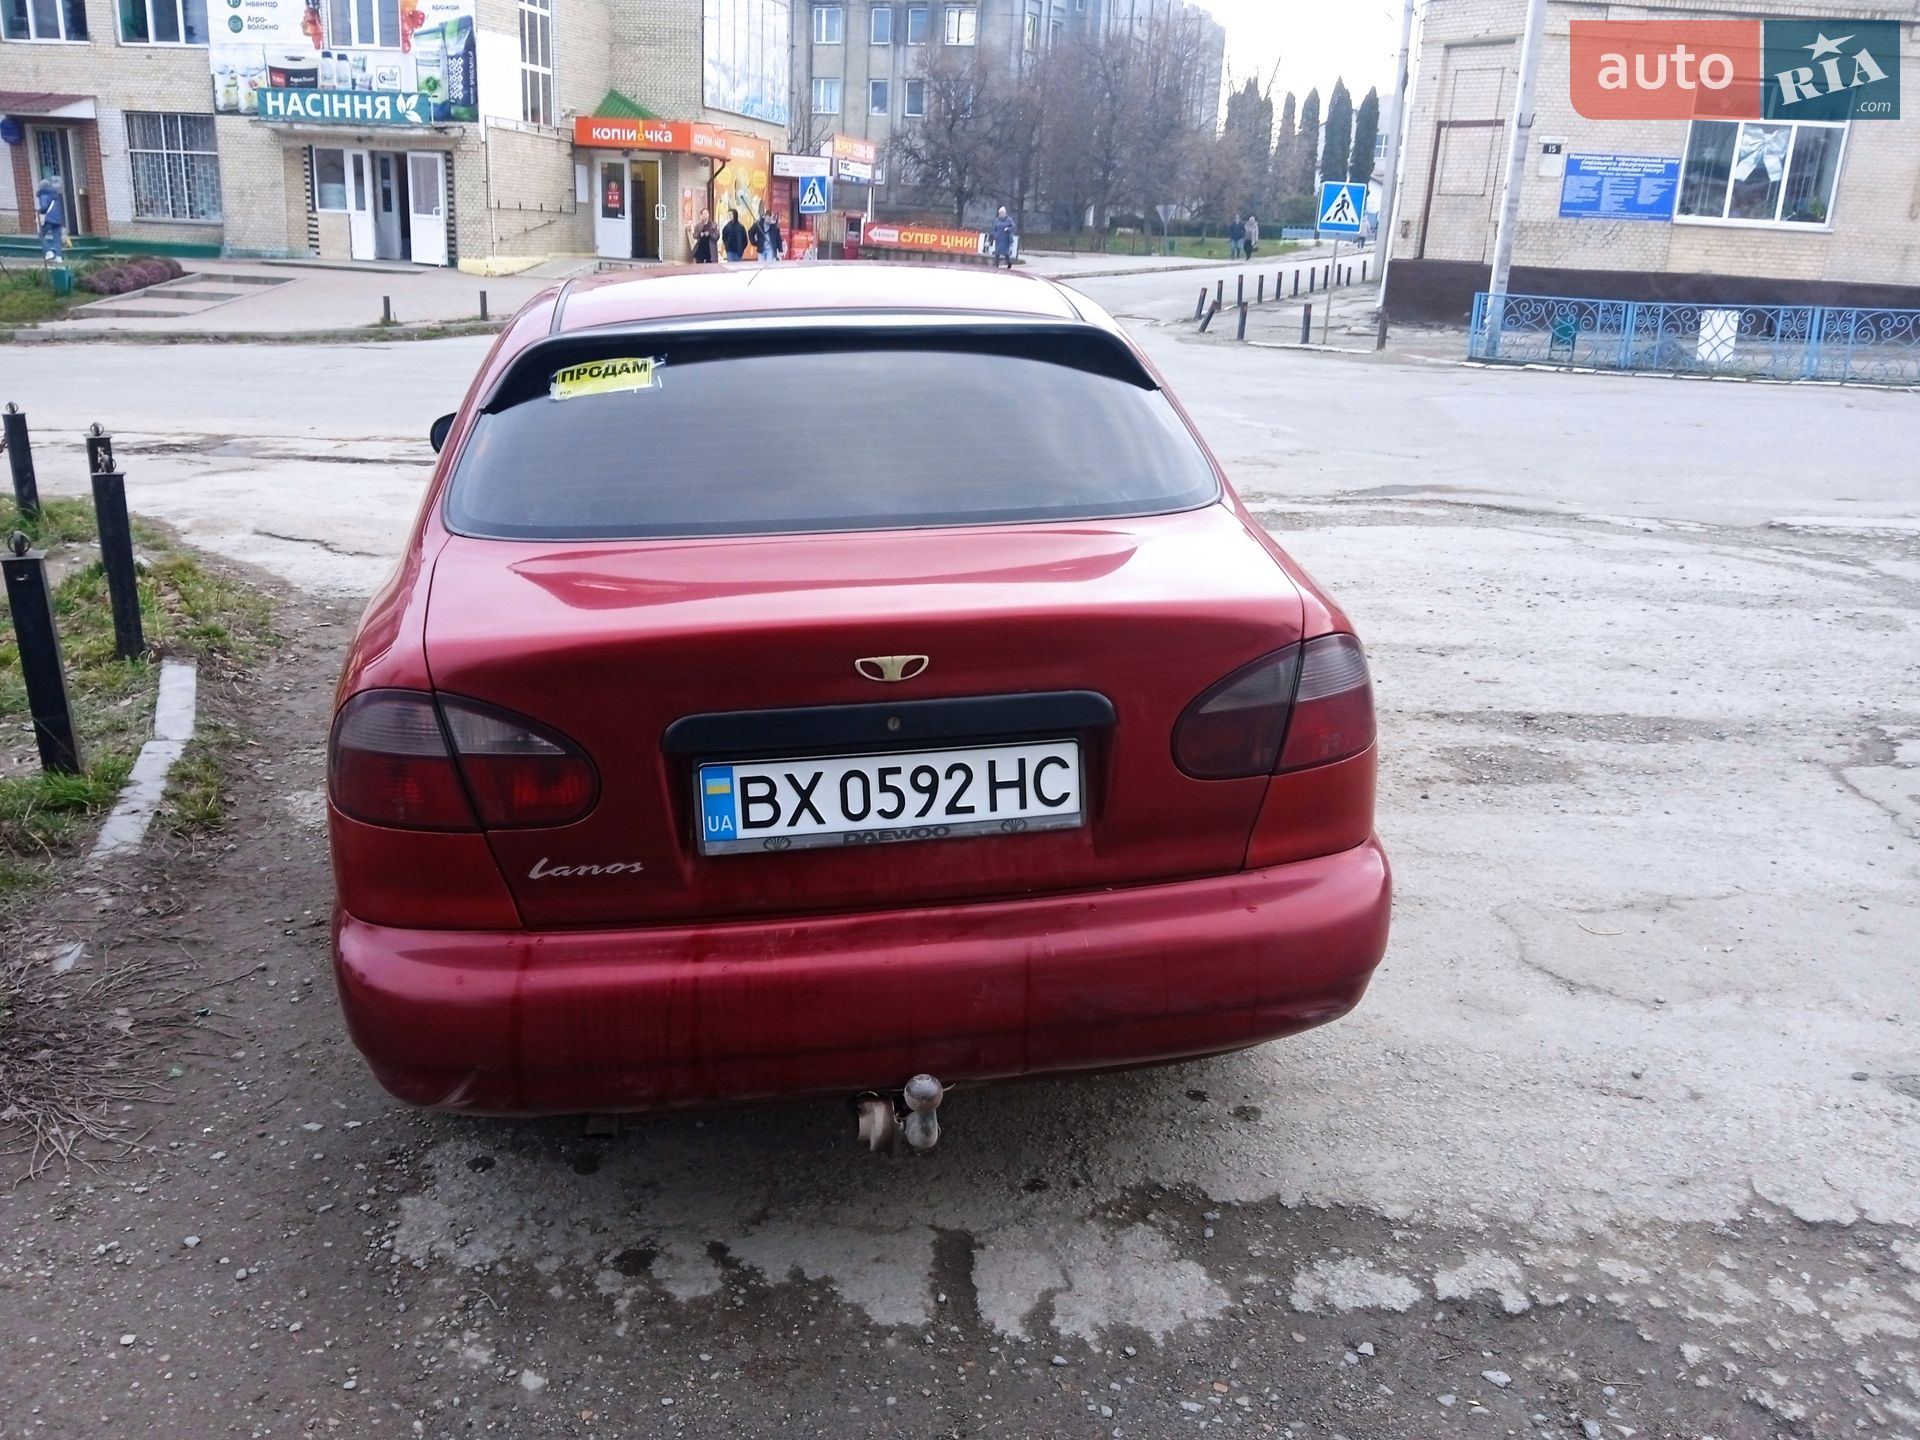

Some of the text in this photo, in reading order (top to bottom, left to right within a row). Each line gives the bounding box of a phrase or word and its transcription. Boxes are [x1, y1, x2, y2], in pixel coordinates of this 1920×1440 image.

[266, 92, 391, 119] НАСІННЯ
[1548, 145, 1556, 153] 15
[900, 231, 937, 244] СУПЕР
[941, 234, 977, 248] ЦІНИ!
[560, 361, 648, 382] ПРОДАМ
[740, 755, 1071, 829] BX 0592 HC
[708, 815, 733, 832] UA
[843, 826, 951, 844] DAEWOO
[528, 857, 645, 880] Lanos
